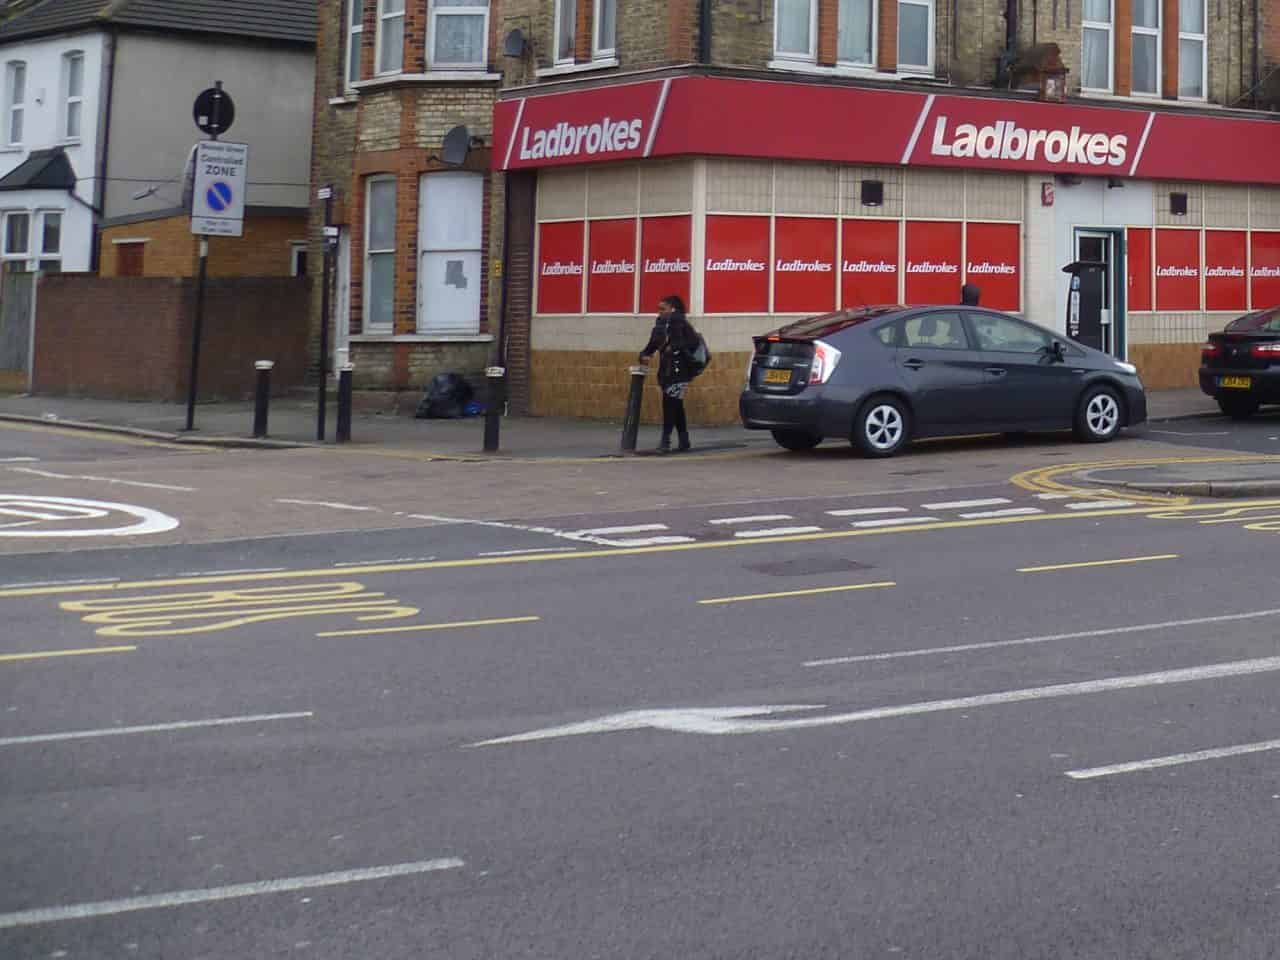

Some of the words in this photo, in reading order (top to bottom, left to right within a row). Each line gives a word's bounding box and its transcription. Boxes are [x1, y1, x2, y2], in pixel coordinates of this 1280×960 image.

[520, 117, 642, 160] Ladbrokes
[931, 116, 1127, 166] Ladbrokes
[206, 164, 236, 176] ZONE
[542, 261, 583, 275] Ladbrokes
[592, 259, 635, 274] Ladbrokes
[645, 258, 691, 273] Ladbrokes
[706, 259, 765, 272] Ladbrokes
[776, 259, 832, 272] Ladbrokes
[843, 260, 896, 272] Ladbrokes
[906, 261, 958, 273] Ladbrokes
[967, 262, 1016, 274] Ladbrokes
[1156, 265, 1198, 277] Ladbrokes
[1205, 266, 1244, 277] Ladbrokes
[58, 581, 420, 636] BUS
